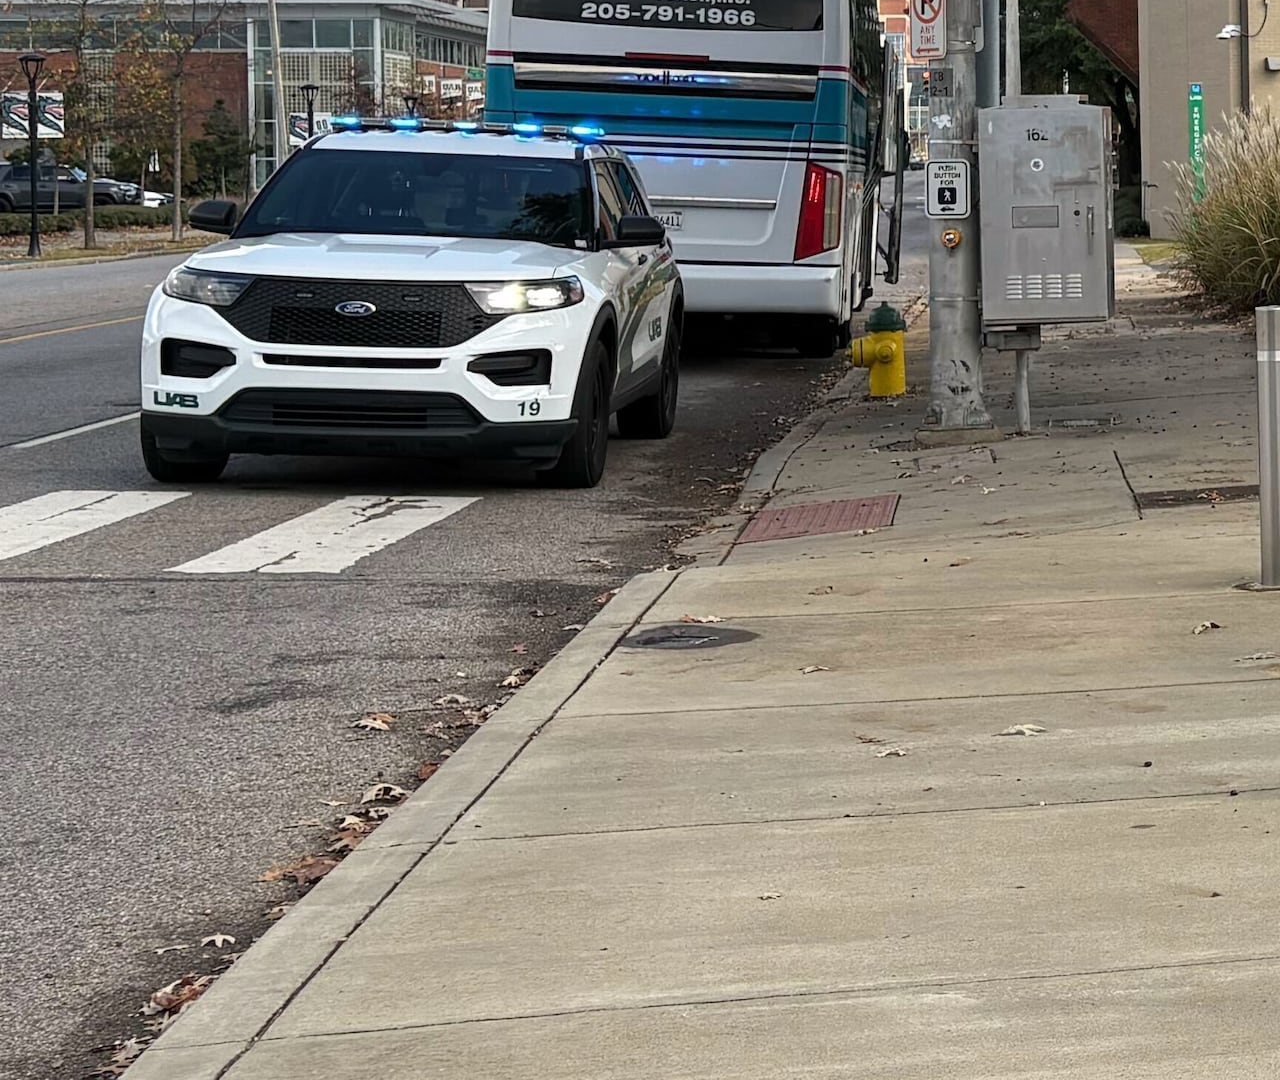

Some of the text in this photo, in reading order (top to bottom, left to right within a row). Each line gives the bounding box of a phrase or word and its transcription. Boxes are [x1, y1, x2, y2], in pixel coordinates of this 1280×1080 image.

[580, 2, 756, 26] 205-791-1966
[920, 25, 936, 35] ANY
[920, 35, 936, 46] TIME
[153, 390, 199, 408] UAB
[517, 400, 541, 417] 19
